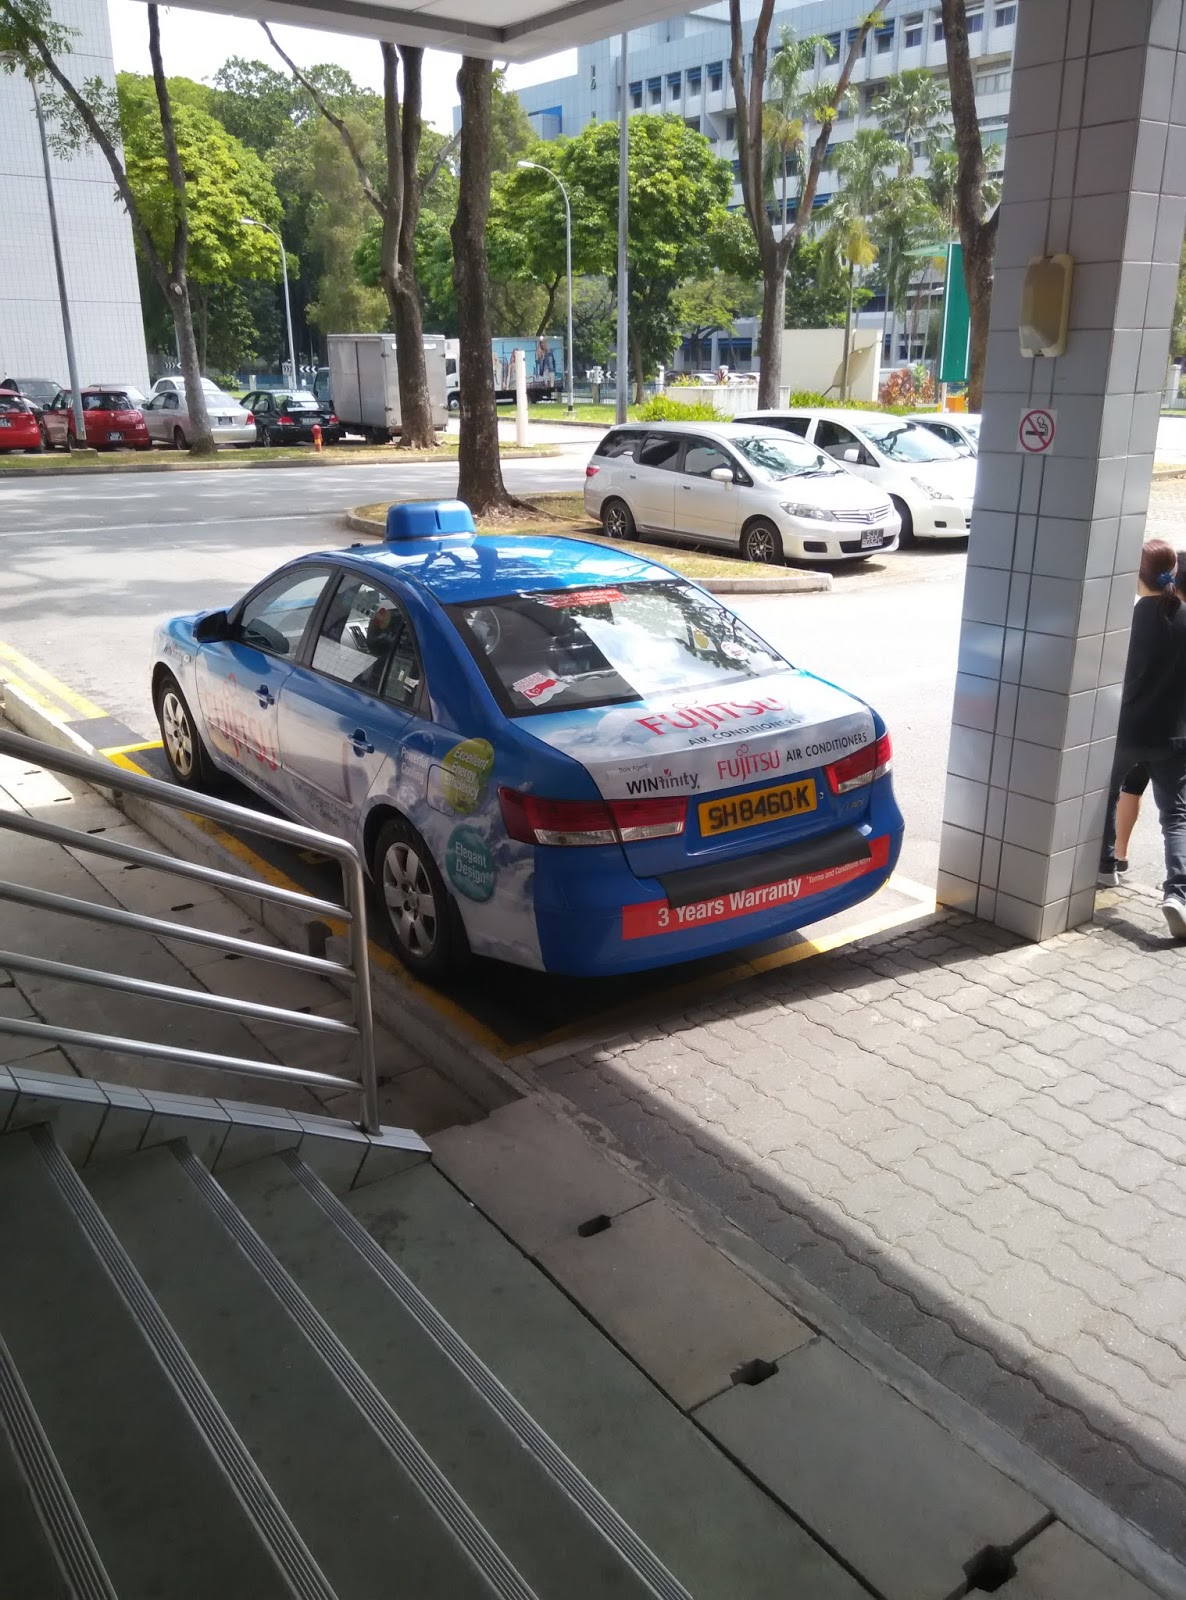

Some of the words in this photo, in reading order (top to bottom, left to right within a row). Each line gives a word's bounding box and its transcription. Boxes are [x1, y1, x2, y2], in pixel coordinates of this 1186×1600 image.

[635, 697, 784, 736] FUJITSU
[688, 736, 709, 746] AIR
[712, 718, 801, 740] CONDITIONERS
[453, 747, 489, 770] Excellent
[717, 749, 781, 782] FUJITSU
[786, 748, 803, 762] AIR
[805, 732, 868, 757] CONDITIONERS
[451, 761, 478, 784] Energy
[708, 785, 811, 830] SH8460K
[455, 841, 487, 869] Elegant
[455, 859, 487, 884] Design
[657, 907, 670, 927] 3
[676, 899, 725, 923] Years
[729, 878, 802, 912] Warranty
